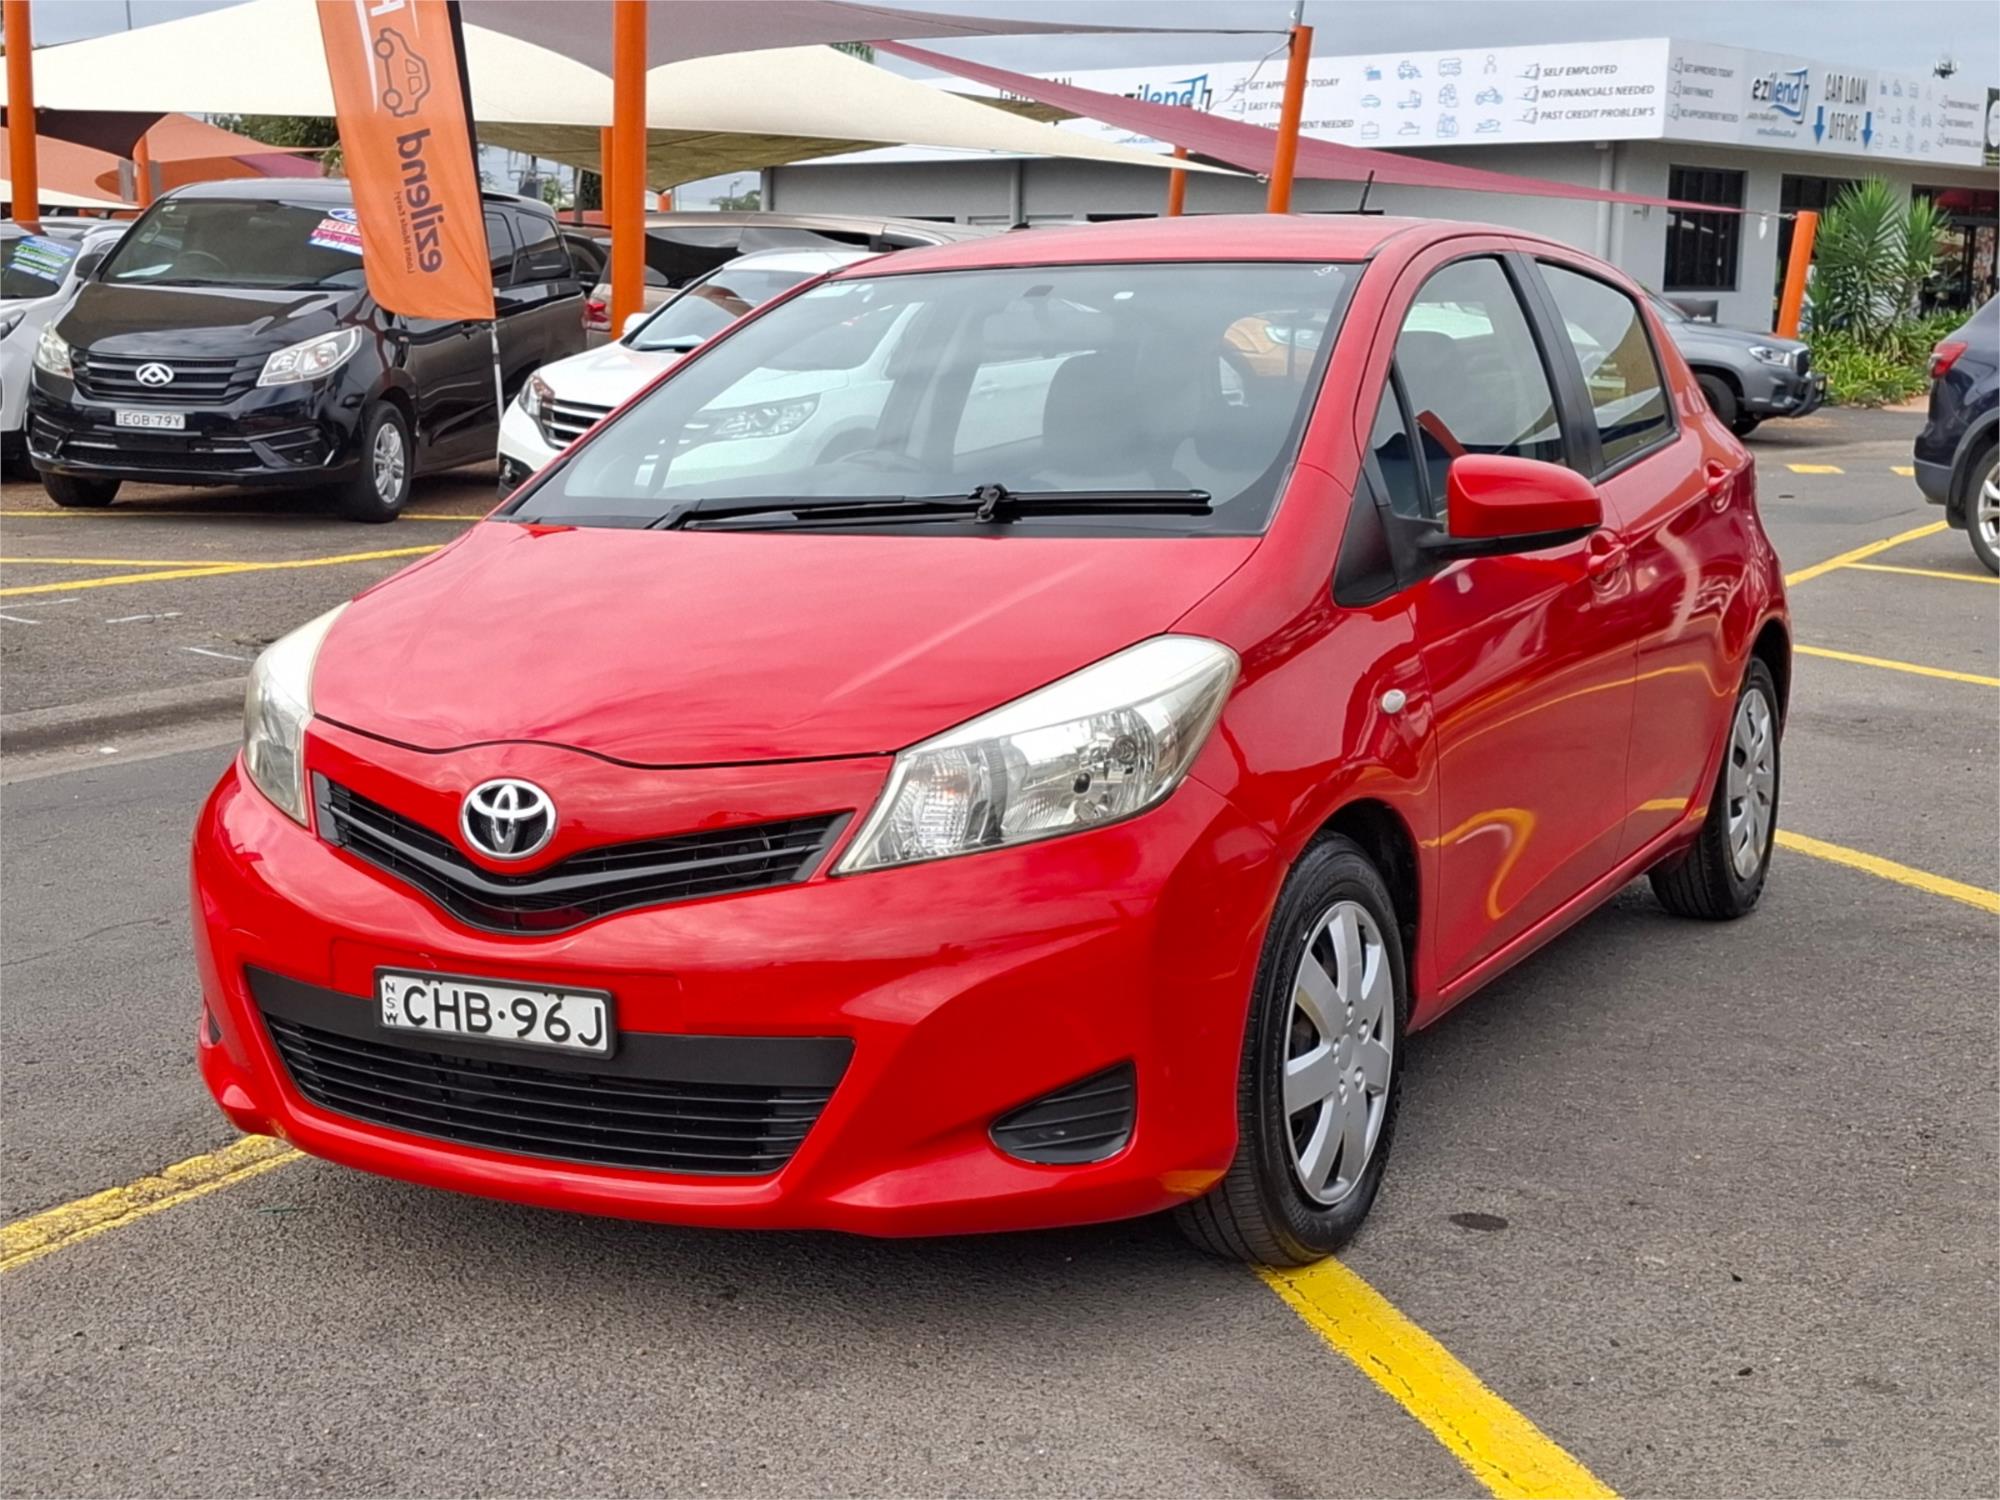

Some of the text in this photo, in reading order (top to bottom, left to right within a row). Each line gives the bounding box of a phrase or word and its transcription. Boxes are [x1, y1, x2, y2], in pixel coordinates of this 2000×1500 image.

[1543, 65, 1618, 77] SELF EMPLOYED
[1248, 81, 1265, 90] GET
[1311, 78, 1340, 88] TODAY
[1752, 72, 1803, 104] ezilend
[1825, 73, 1844, 102] CAR
[1541, 84, 1655, 99] NO FINANCIALS NEEDED
[1248, 102, 1268, 111] EASY
[1540, 107, 1656, 120] PAST CREDIT PROBLEM'S
[1320, 119, 1354, 129] NEEDED
[1828, 112, 1859, 142] OFFICE
